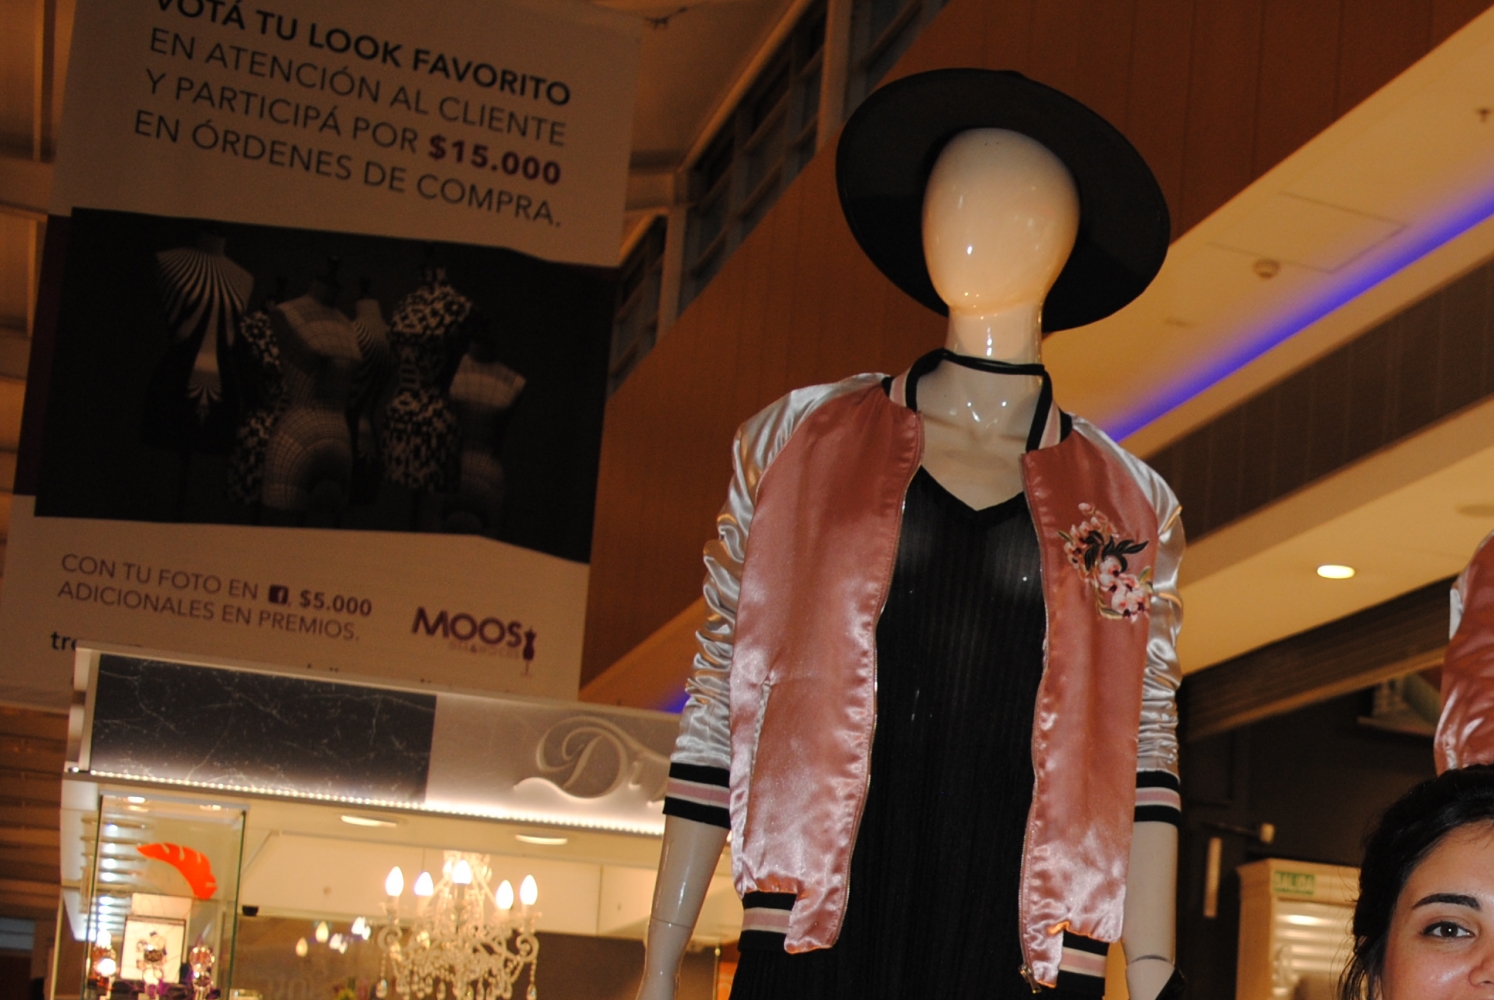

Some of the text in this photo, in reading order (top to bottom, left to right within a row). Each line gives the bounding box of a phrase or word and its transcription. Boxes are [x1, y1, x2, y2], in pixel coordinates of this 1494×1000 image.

[151, 27, 566, 147] EN ATENCIÓN AL CLIENTE
[256, 10, 297, 40] TU
[309, 23, 402, 67] LOOK
[413, 48, 571, 106] FAVORITO
[135, 110, 561, 228] EN ÓRDENES DE COMPRA.
[146, 69, 561, 186] Y PARTICIPÁ POR $15.000
[57, 581, 360, 641] ADICIONALES EN PREMIOS.
[61, 553, 116, 578] CON
[123, 562, 151, 584] TU
[159, 569, 221, 594] FOTO
[229, 579, 258, 600] EN
[299, 589, 372, 617] $5.000
